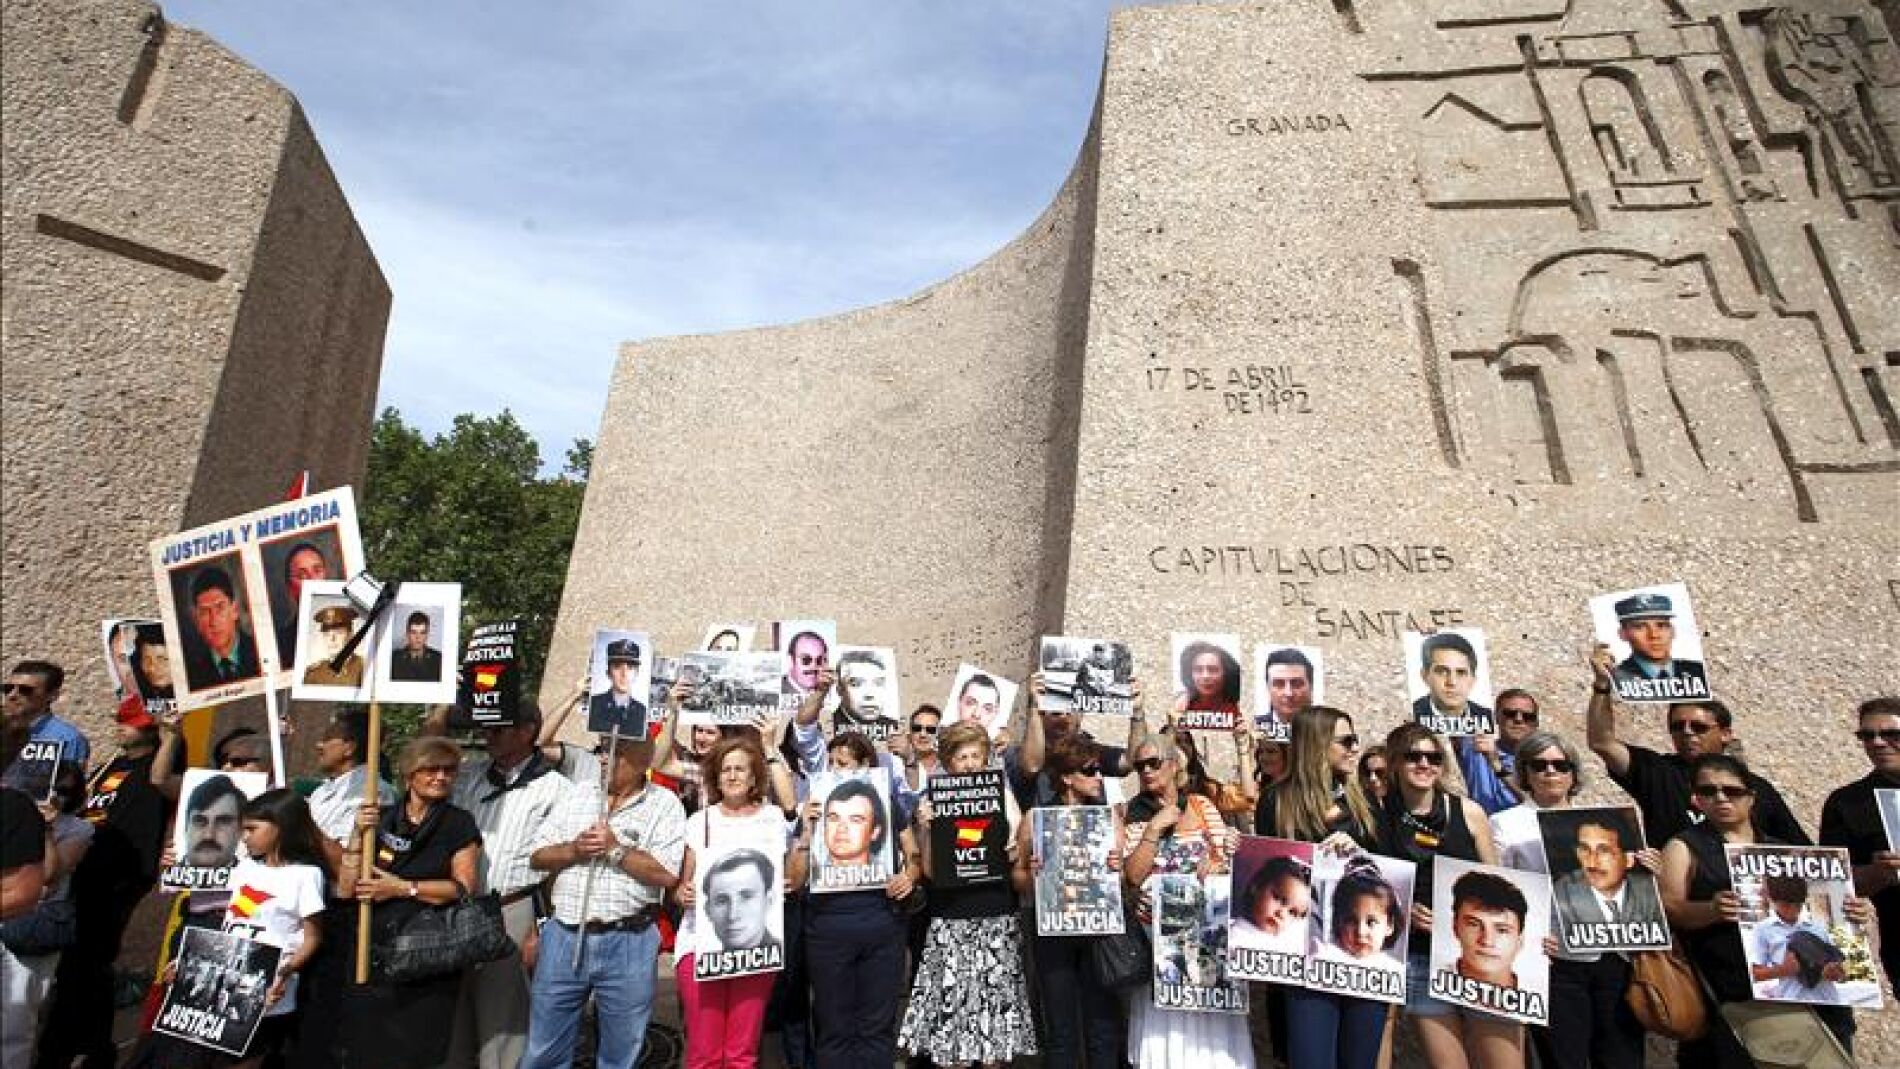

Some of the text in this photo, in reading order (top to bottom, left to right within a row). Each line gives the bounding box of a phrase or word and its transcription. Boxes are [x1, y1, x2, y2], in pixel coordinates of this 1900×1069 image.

[1228, 112, 1352, 136] GRANADA
[1146, 364, 1306, 391] 17 DE ABRIL
[1223, 390, 1313, 414] DE 1492
[162, 499, 341, 565] JUSTICIA Y MEMORIA
[1150, 543, 1455, 577] CAPITULACIONES
[1280, 581, 1317, 607] DE
[1620, 675, 1706, 698] JUSTICIA
[930, 776, 974, 788] FRENTE
[934, 799, 1001, 818] JUSTICIA
[954, 847, 988, 863] VCT
[1734, 854, 1847, 880] JUSTICIA
[161, 866, 229, 886] JUSTIC
[817, 863, 887, 887] JUSTICIA
[1041, 910, 1120, 932] JUSTICIA
[1568, 922, 1667, 946] JUSTICIA
[697, 944, 781, 974] JUSTICIA
[1229, 947, 1304, 977] JUSTIC
[1308, 959, 1402, 999] JUSTICIA
[1159, 984, 1243, 1010] JUSTICIA
[1431, 968, 1546, 1019] JUSTICIA
[162, 1003, 227, 1042] JUSTICIA
